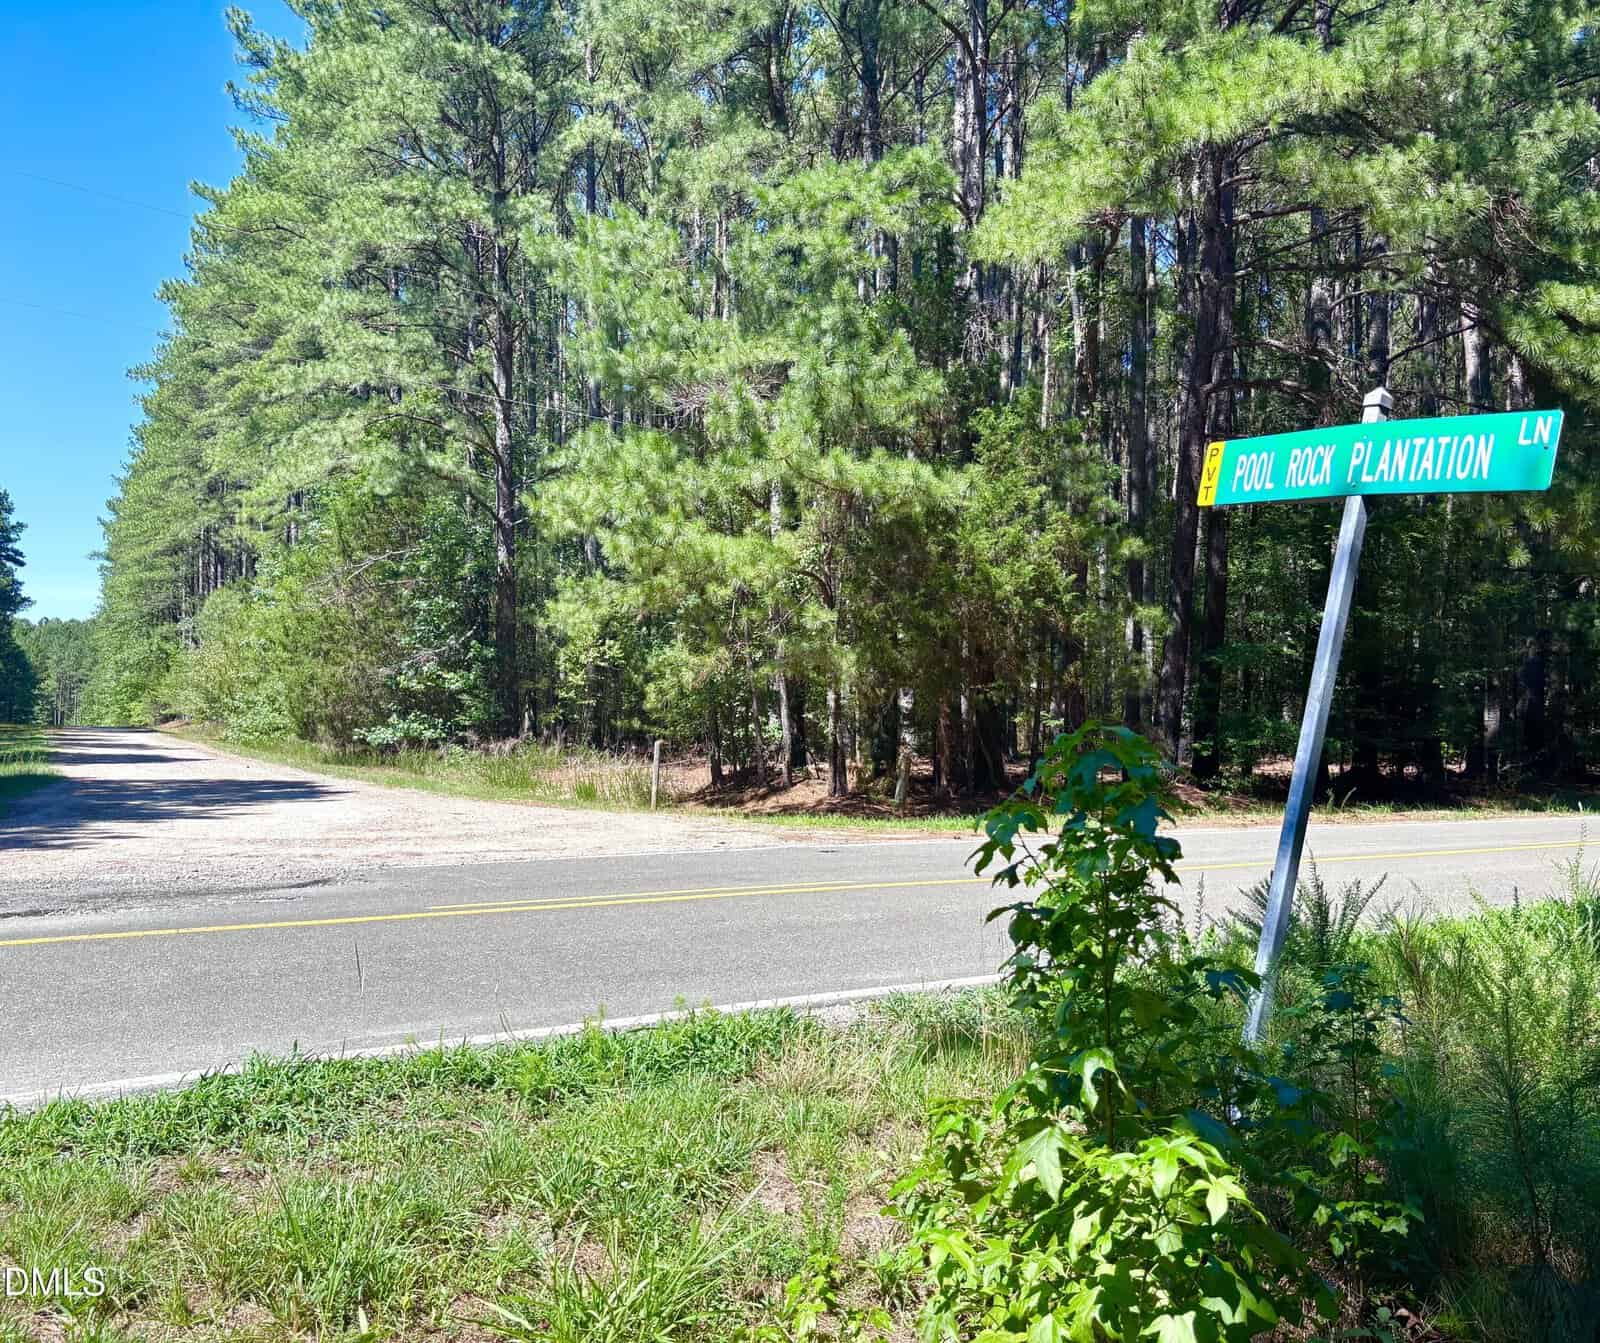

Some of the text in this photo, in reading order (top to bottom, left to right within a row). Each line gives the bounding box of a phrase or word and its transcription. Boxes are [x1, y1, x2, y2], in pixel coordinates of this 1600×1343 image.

[1204, 448, 1219, 501] PVT
[1232, 416, 1553, 492] POOL ROCK PLANTATION LN
